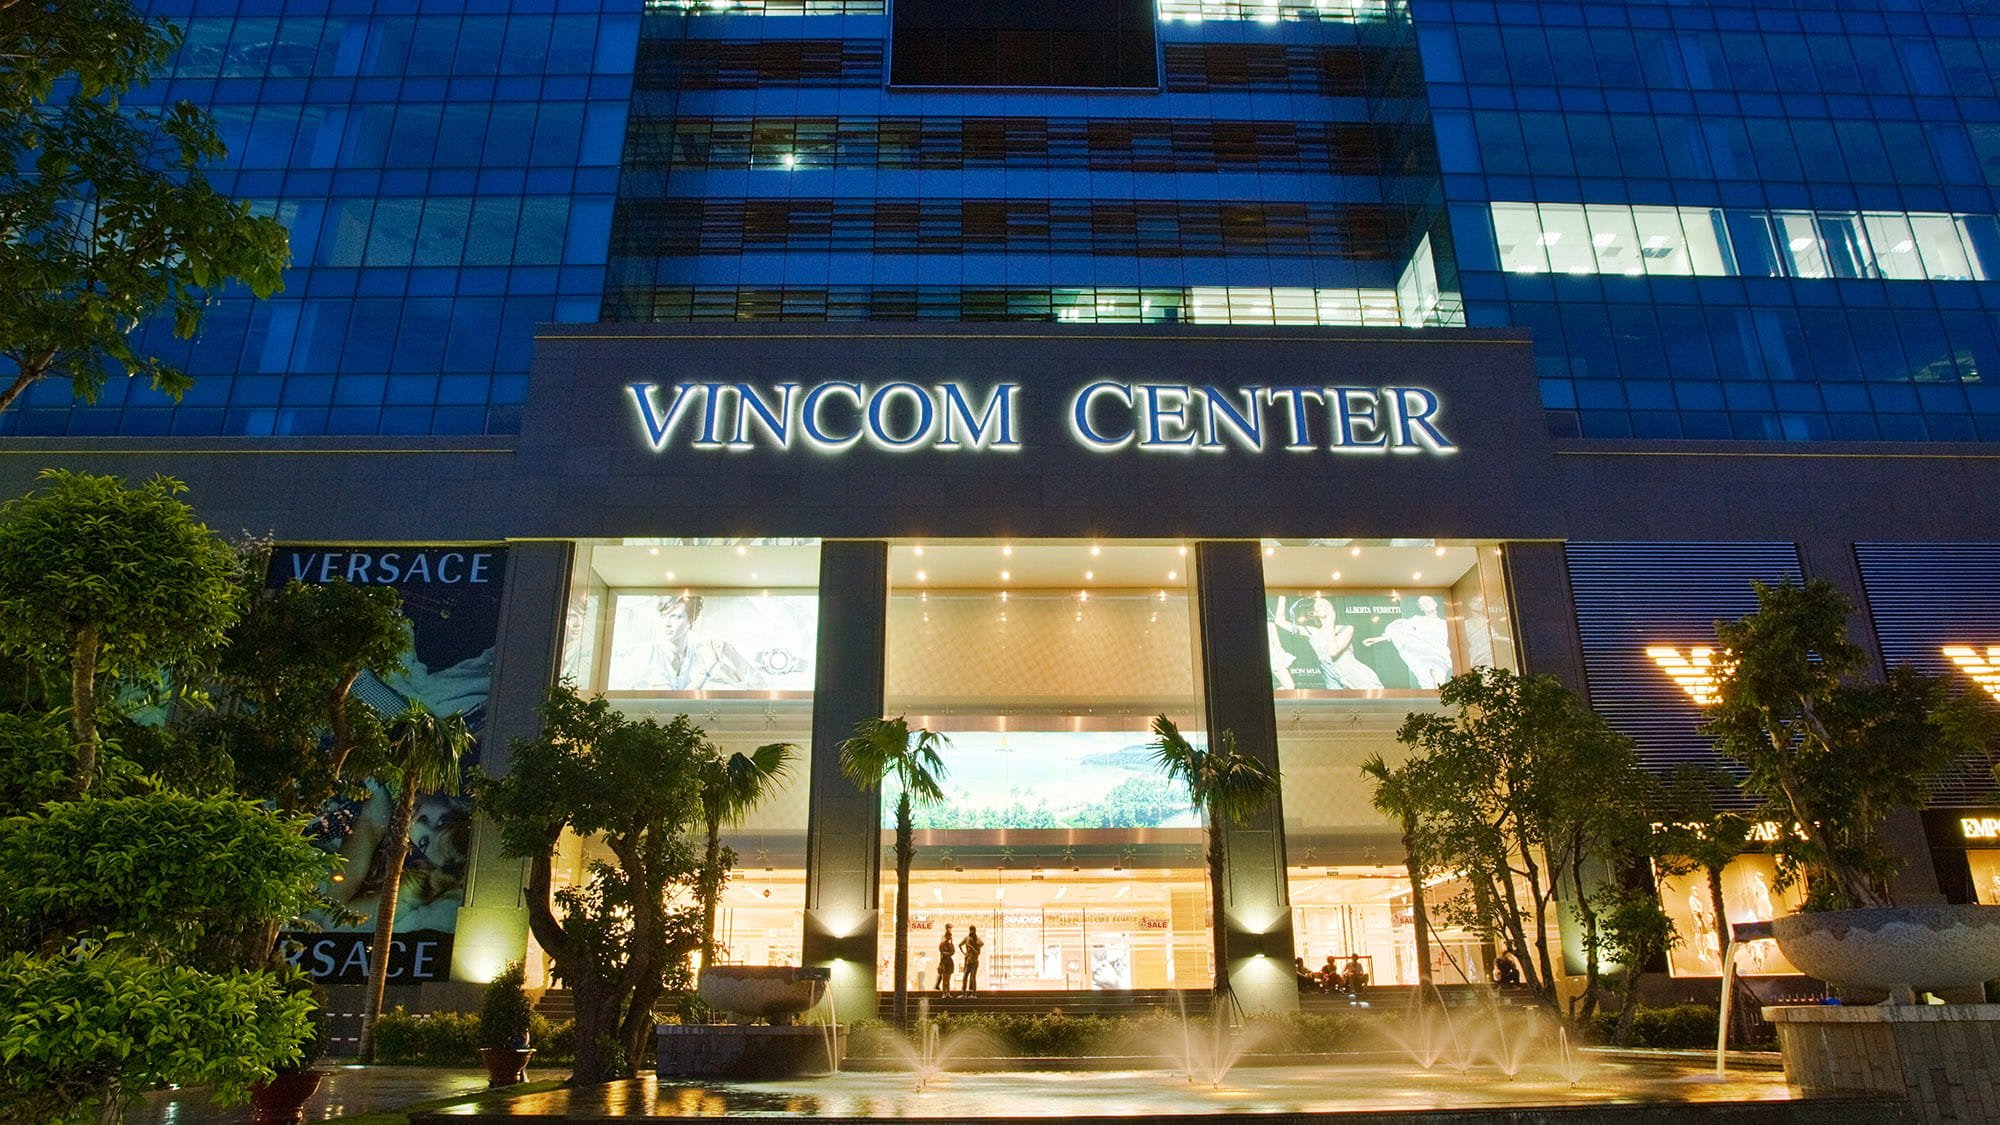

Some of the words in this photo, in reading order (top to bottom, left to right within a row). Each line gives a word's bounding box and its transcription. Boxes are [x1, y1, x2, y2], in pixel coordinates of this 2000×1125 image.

[624, 381, 1023, 454] VINCOM
[1068, 381, 1459, 456] CENTER
[291, 552, 492, 584] VERSACE
[1960, 818, 2000, 838] EMP
[911, 922, 932, 930] SALE
[1146, 921, 1168, 929] SALE
[280, 939, 438, 978] RSACE
